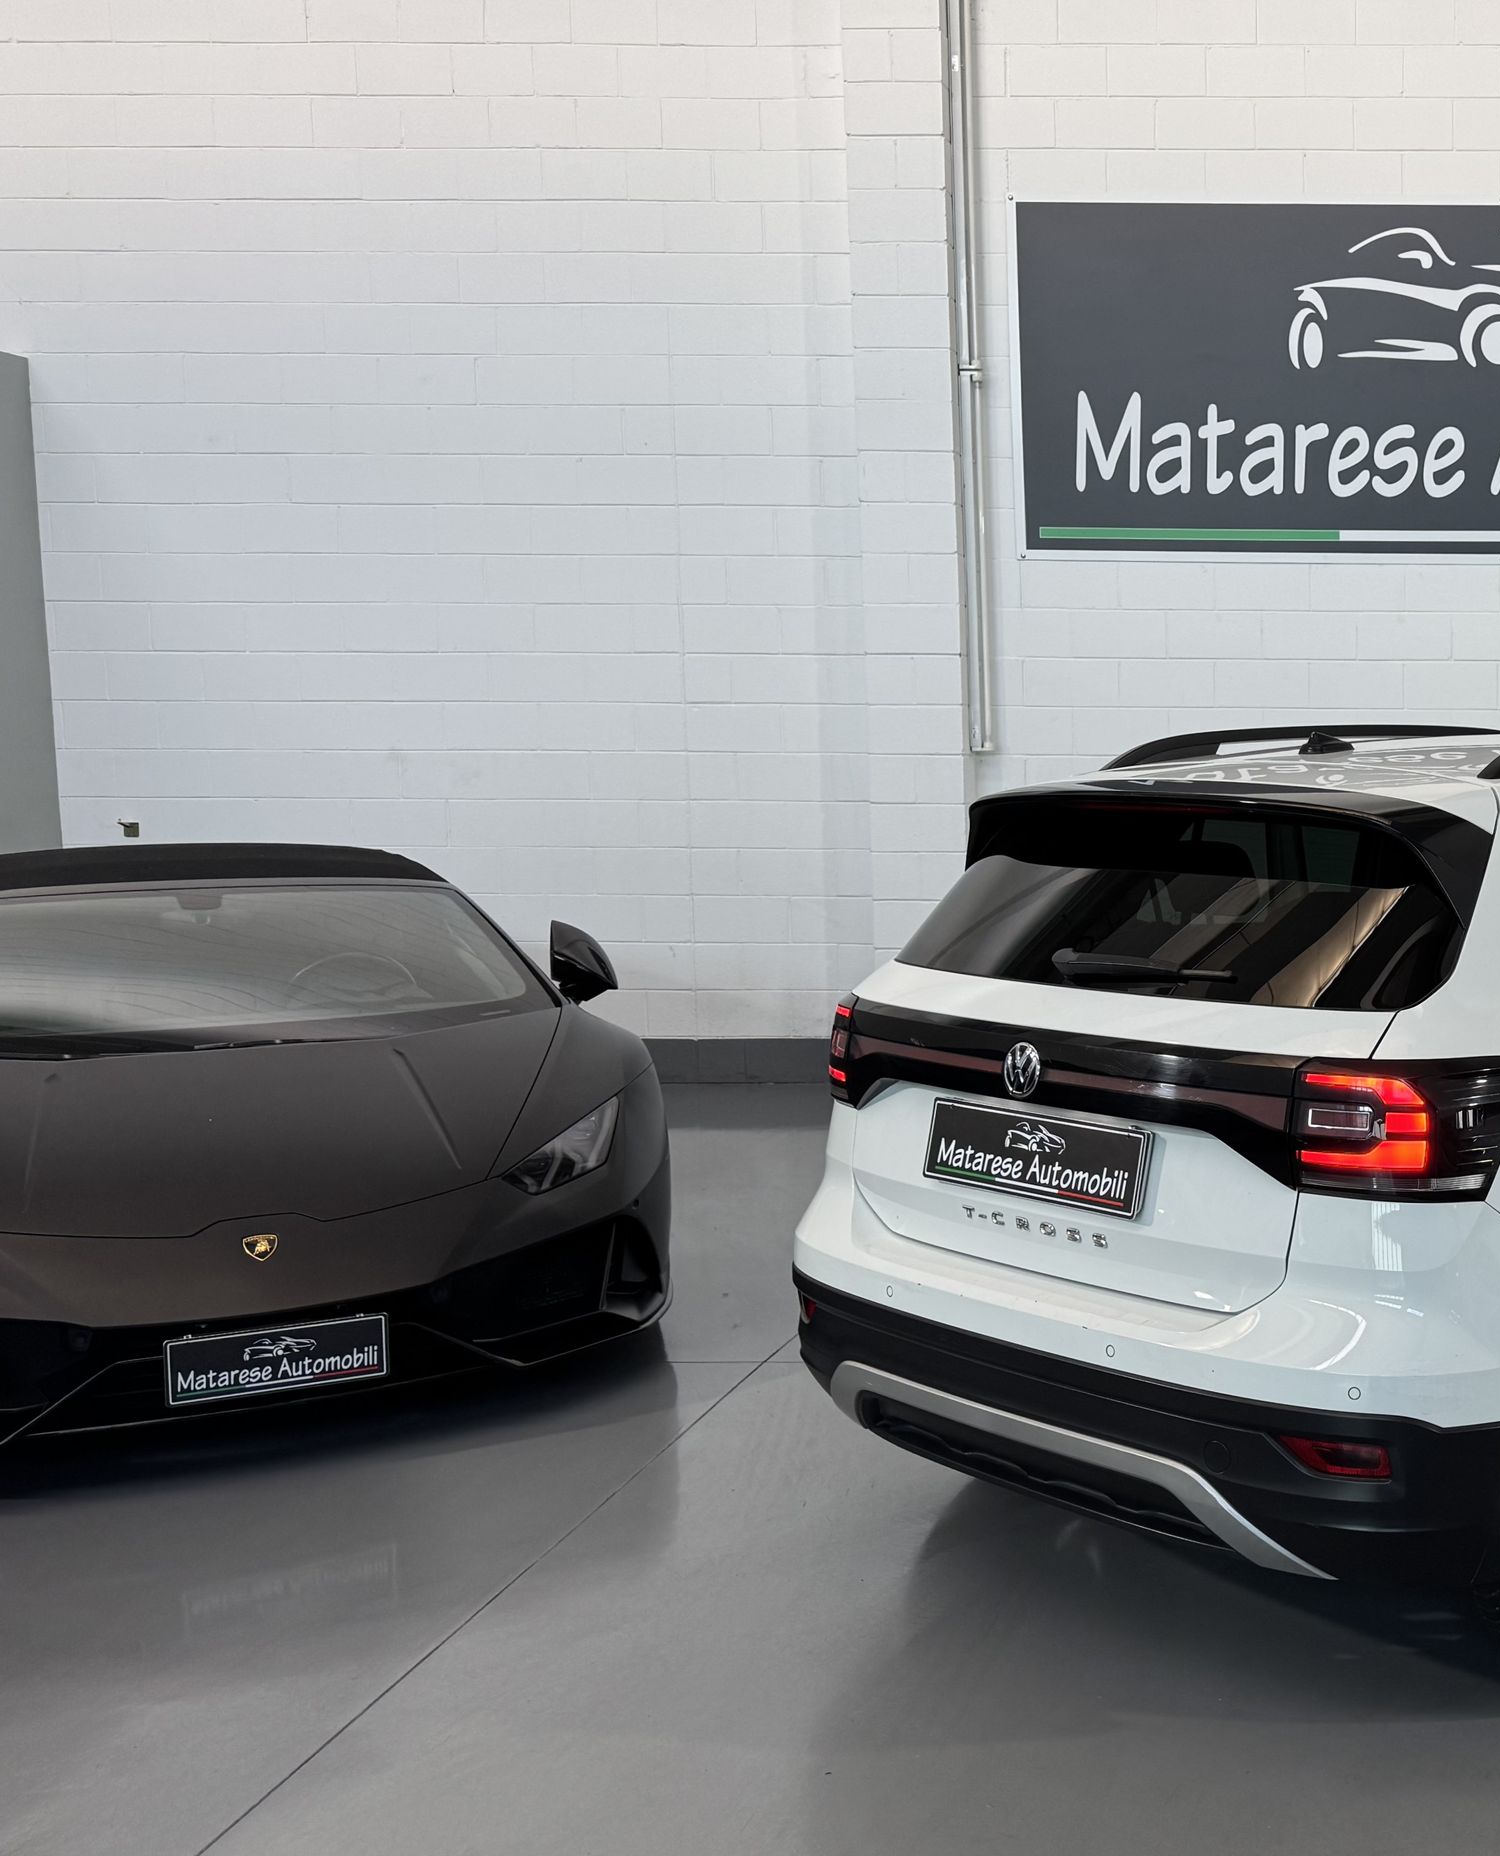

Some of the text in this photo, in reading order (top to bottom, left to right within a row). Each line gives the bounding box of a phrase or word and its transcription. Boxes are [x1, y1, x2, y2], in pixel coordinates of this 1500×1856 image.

[1076, 391, 1465, 498] Matarese
[936, 1137, 1129, 1200] Matarese Automobili
[962, 1205, 1108, 1249] T-CROSS
[176, 1345, 378, 1392] Matarese Automobili
